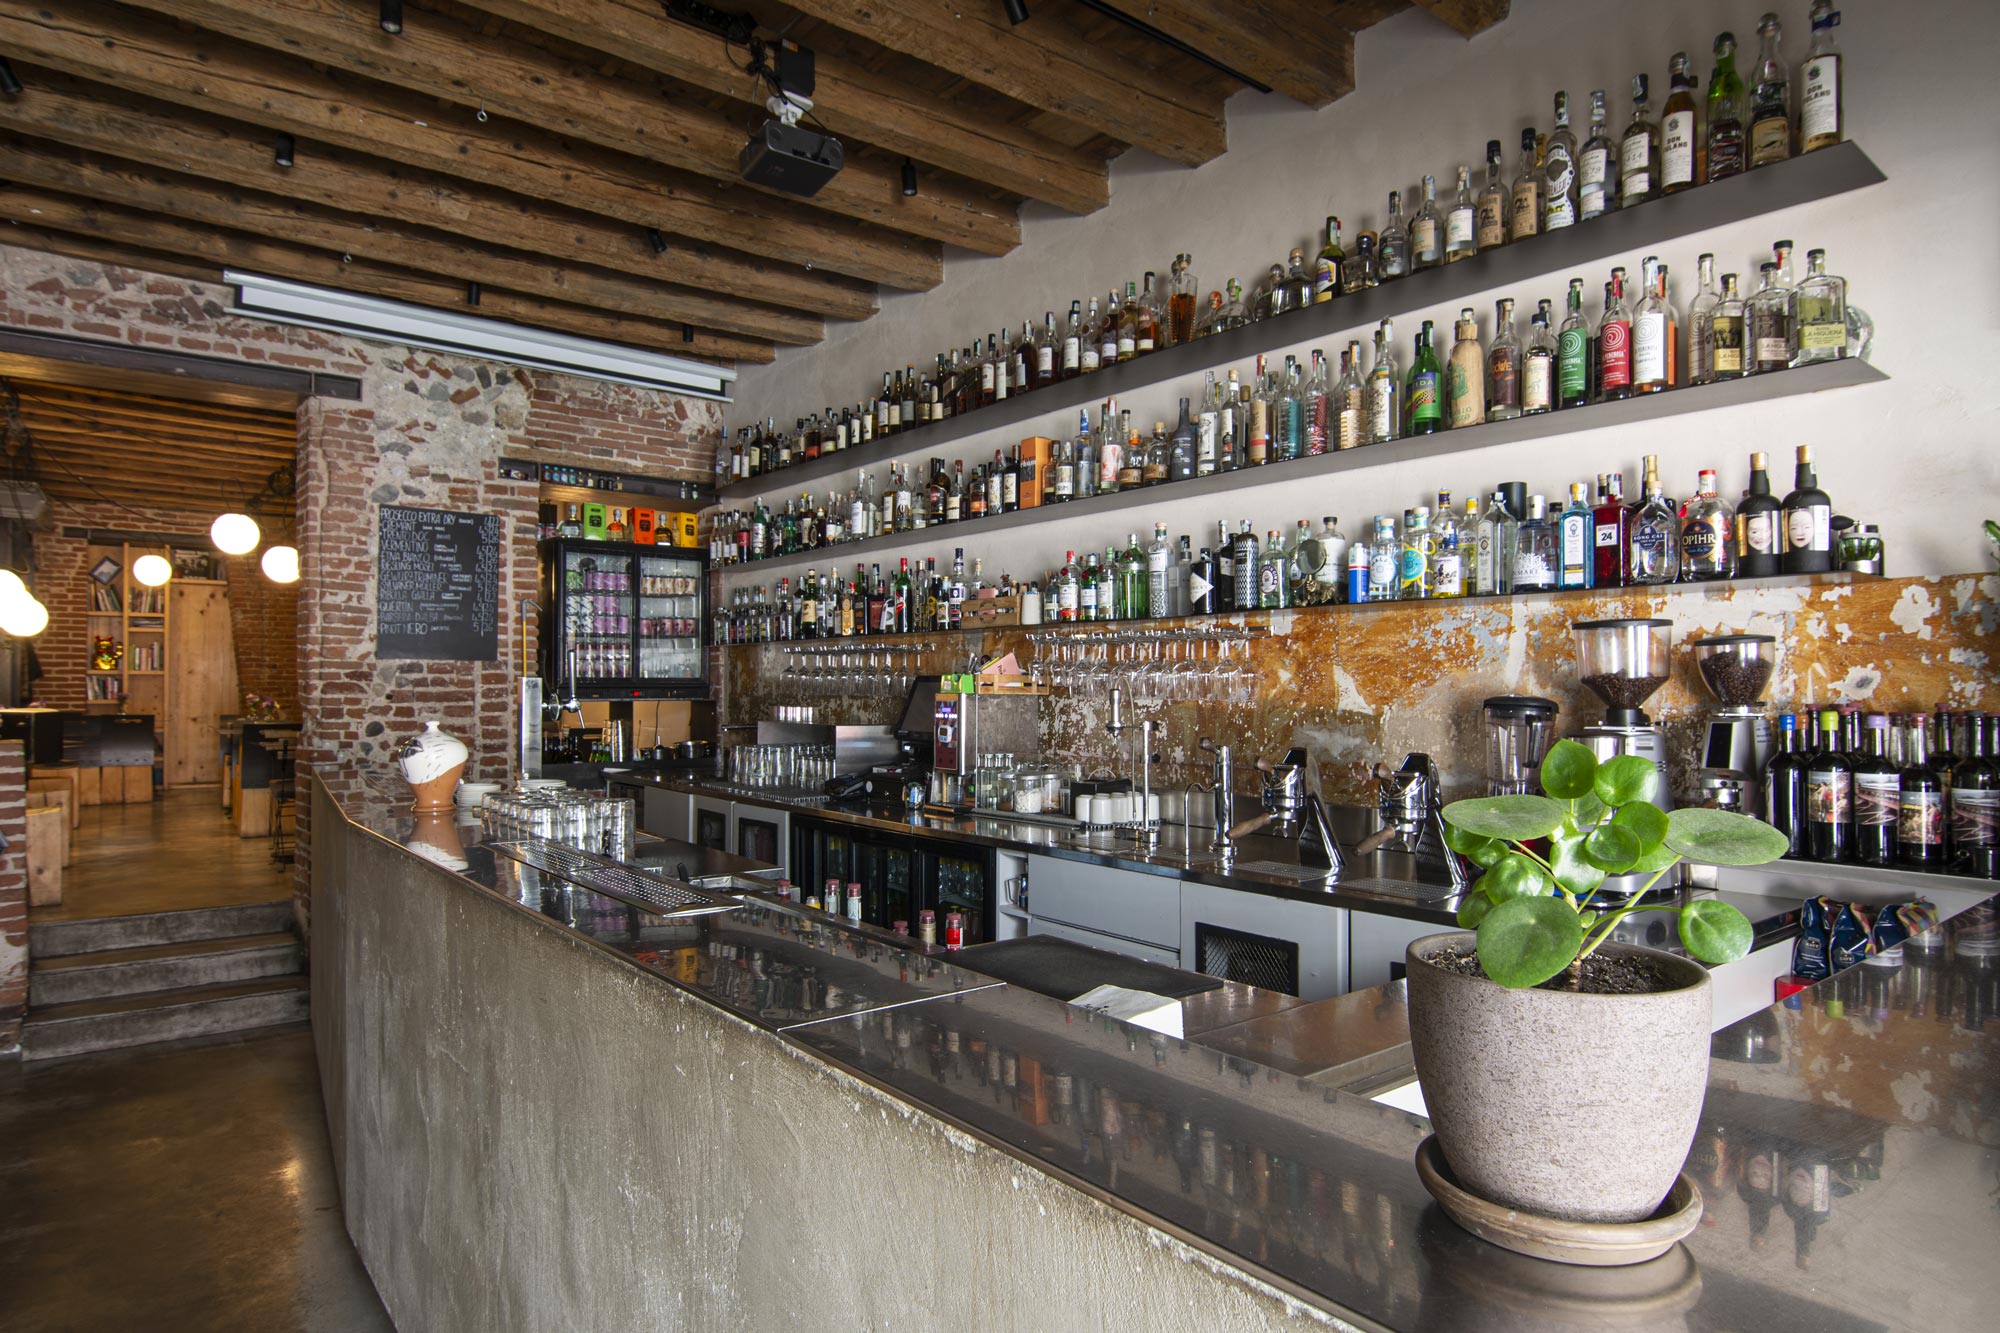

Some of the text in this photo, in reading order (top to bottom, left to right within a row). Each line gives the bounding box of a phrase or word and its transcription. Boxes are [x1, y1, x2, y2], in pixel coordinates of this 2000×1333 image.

[381, 508, 417, 521] PROSECCO
[419, 511, 441, 524] EXTRA
[443, 513, 456, 525] DRY
[1601, 532, 1613, 542] 24
[1682, 533, 1716, 546] OPIHR
[382, 540, 429, 552] VERMENTINO
